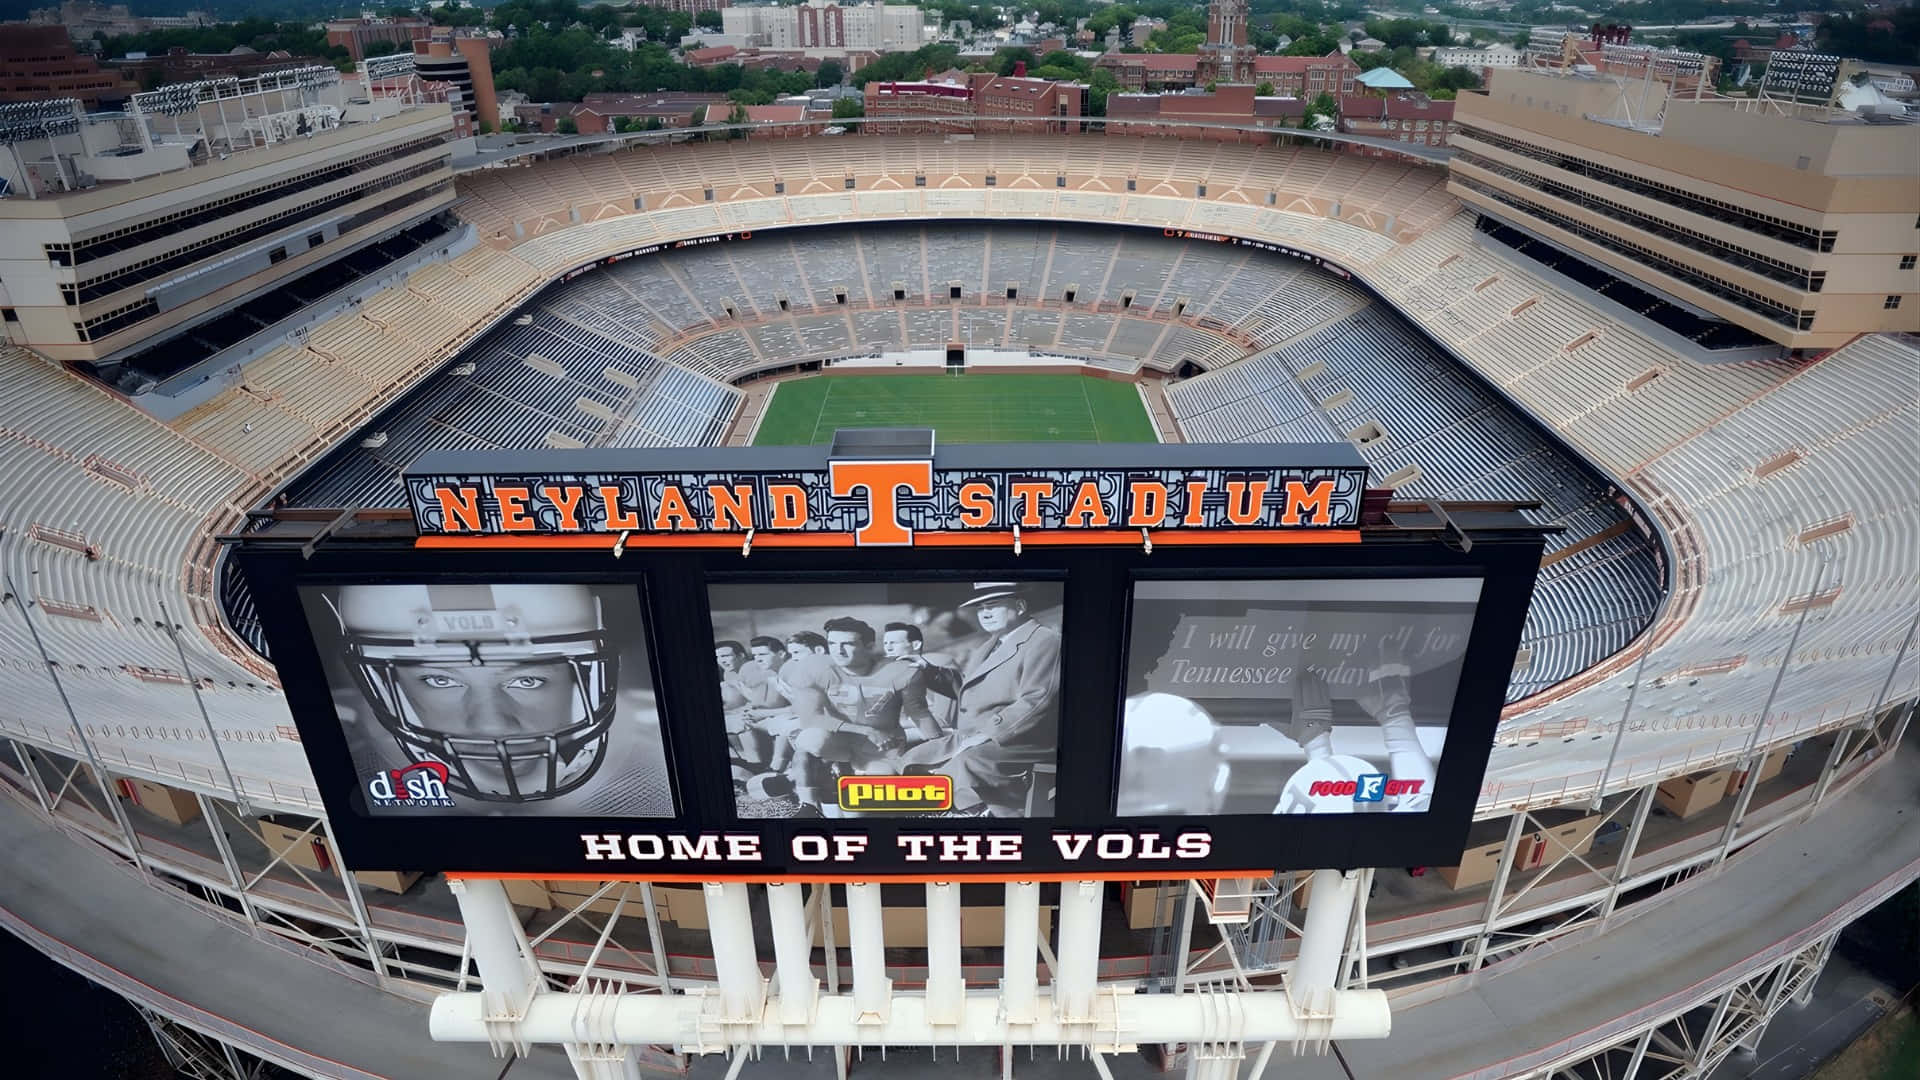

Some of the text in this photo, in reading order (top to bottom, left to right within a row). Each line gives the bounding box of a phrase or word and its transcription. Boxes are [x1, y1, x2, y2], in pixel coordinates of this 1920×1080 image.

[434, 483, 809, 531] NEYLAND
[829, 459, 934, 547] T
[958, 480, 1336, 527] STADIUM
[443, 615, 496, 632] VOLS
[1183, 624, 1198, 649] I
[1209, 624, 1256, 650] will
[1262, 625, 1318, 657] give
[1328, 631, 1367, 657] my
[1416, 625, 1462, 658] for
[1170, 658, 1293, 684] Tennessee
[369, 761, 450, 800] dish
[847, 783, 946, 806] Pilot
[1309, 781, 1357, 796] FOOD
[1385, 779, 1425, 796] CITY
[373, 799, 456, 808] NETWORK
[580, 832, 1213, 861] HOME OF THE VOLS
